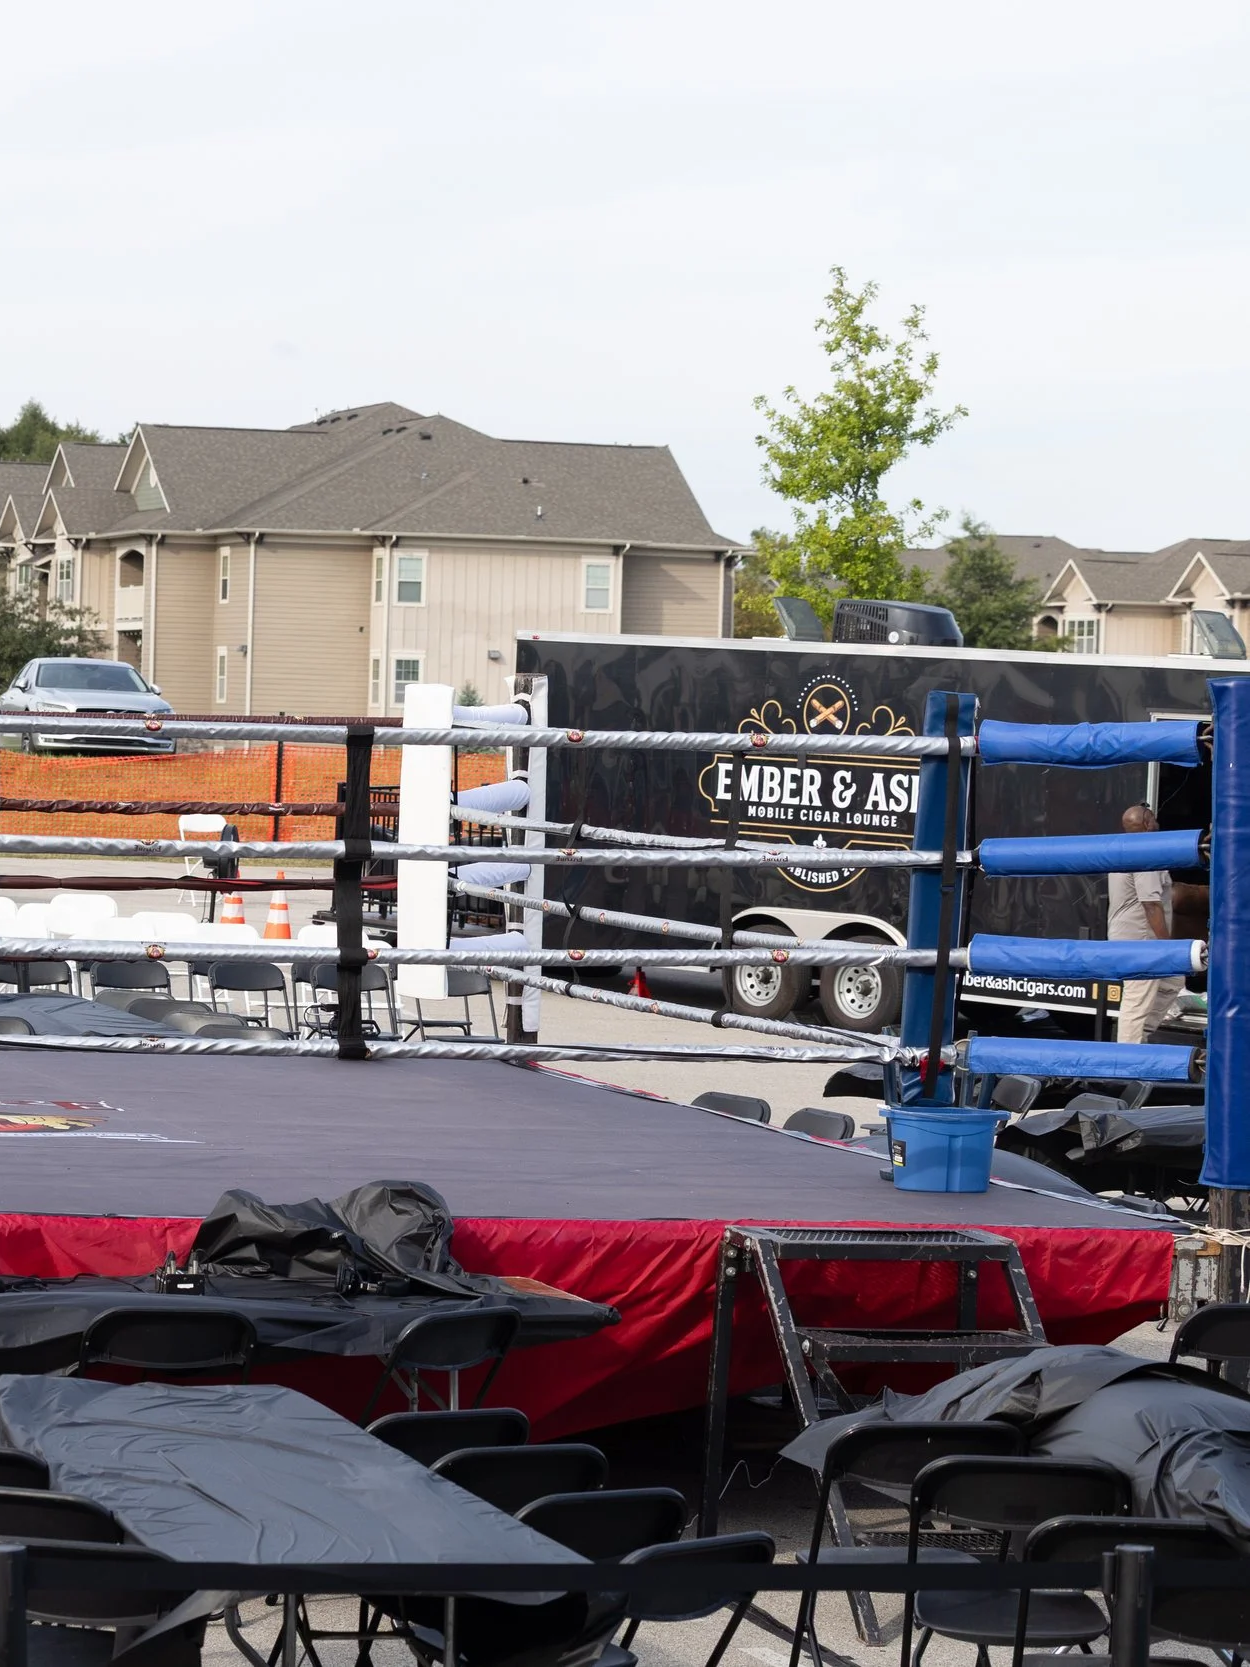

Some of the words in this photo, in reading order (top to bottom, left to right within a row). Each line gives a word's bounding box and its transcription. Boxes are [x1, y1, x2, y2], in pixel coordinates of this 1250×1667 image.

[715, 762, 822, 806] EMBER
[832, 770, 857, 809] &
[747, 805, 794, 820] MOBILE
[800, 809, 840, 823] CIGAR
[846, 812, 898, 828] LOUNGE
[962, 970, 1086, 998] ber&ashcigars.com
